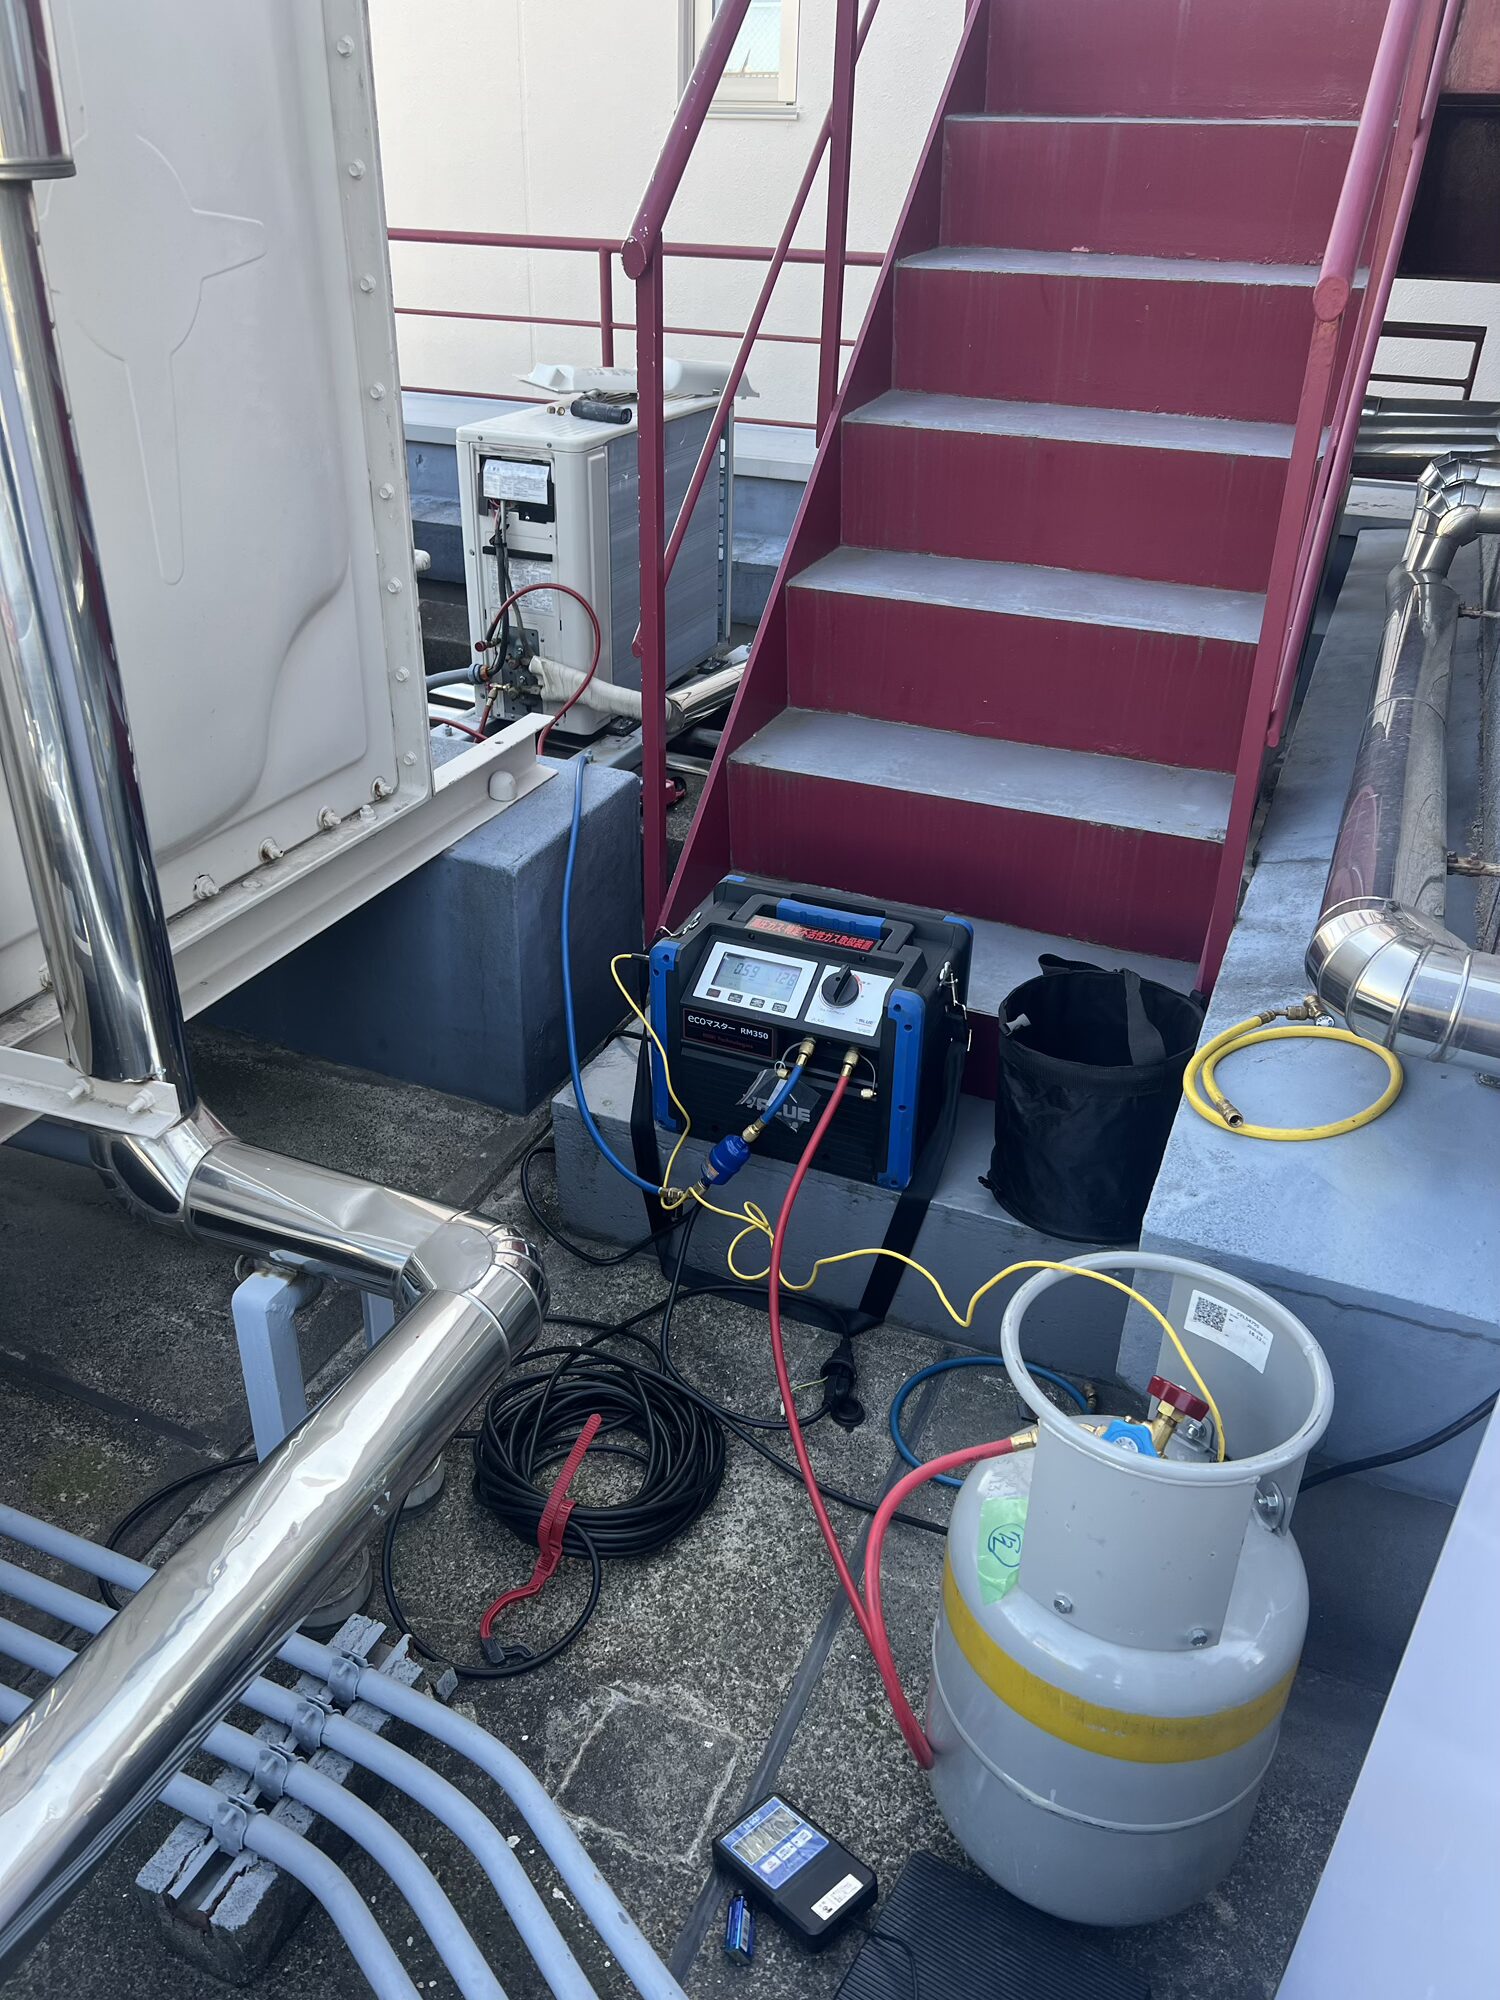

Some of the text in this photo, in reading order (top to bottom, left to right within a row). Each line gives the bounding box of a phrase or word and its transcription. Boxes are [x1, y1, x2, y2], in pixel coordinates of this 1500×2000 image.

[688, 1015, 769, 1040] ecoマスター RM350
